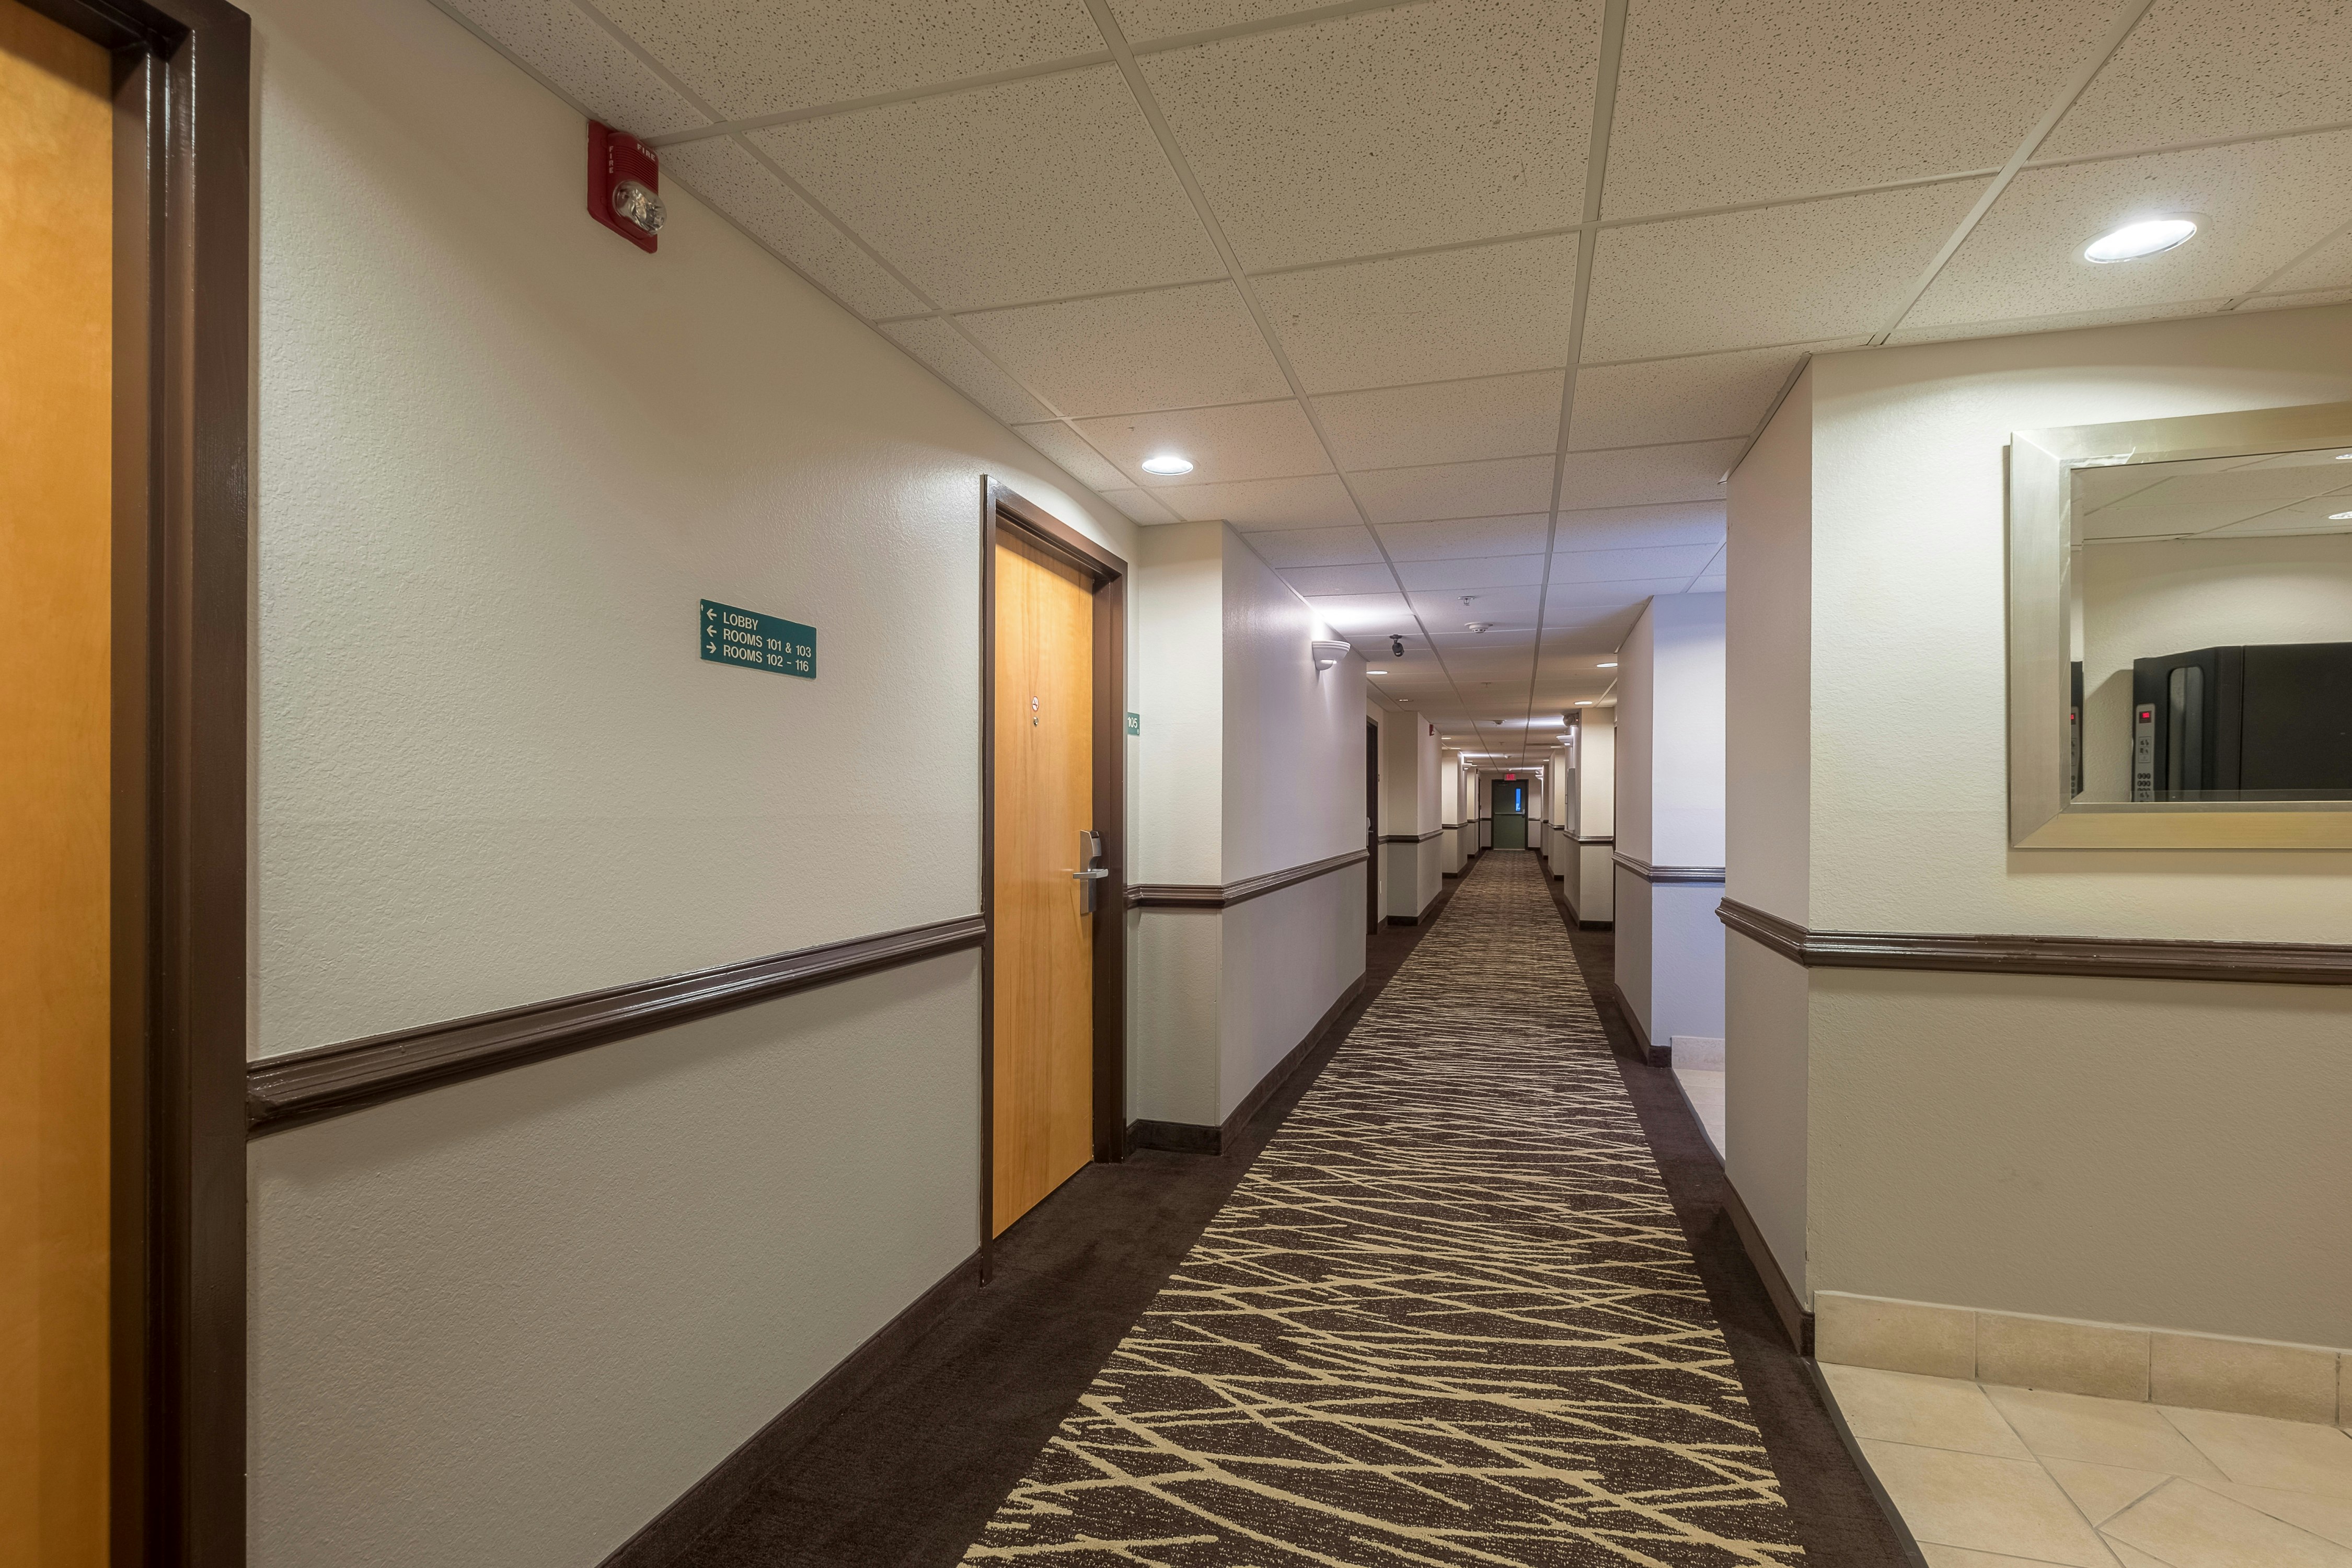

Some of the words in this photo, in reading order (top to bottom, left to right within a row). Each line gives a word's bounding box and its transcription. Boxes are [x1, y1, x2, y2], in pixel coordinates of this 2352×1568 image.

[637, 143, 655, 162] FIRE
[723, 612, 758, 630] LOBBY
[723, 628, 763, 648] ROOMS
[766, 638, 781, 651] 101
[785, 642, 792, 653] &
[795, 645, 811, 658] 103
[723, 644, 763, 663] ROOMS
[766, 653, 783, 667] 102
[795, 659, 809, 672] 116
[1127, 717, 1138, 729] 105
